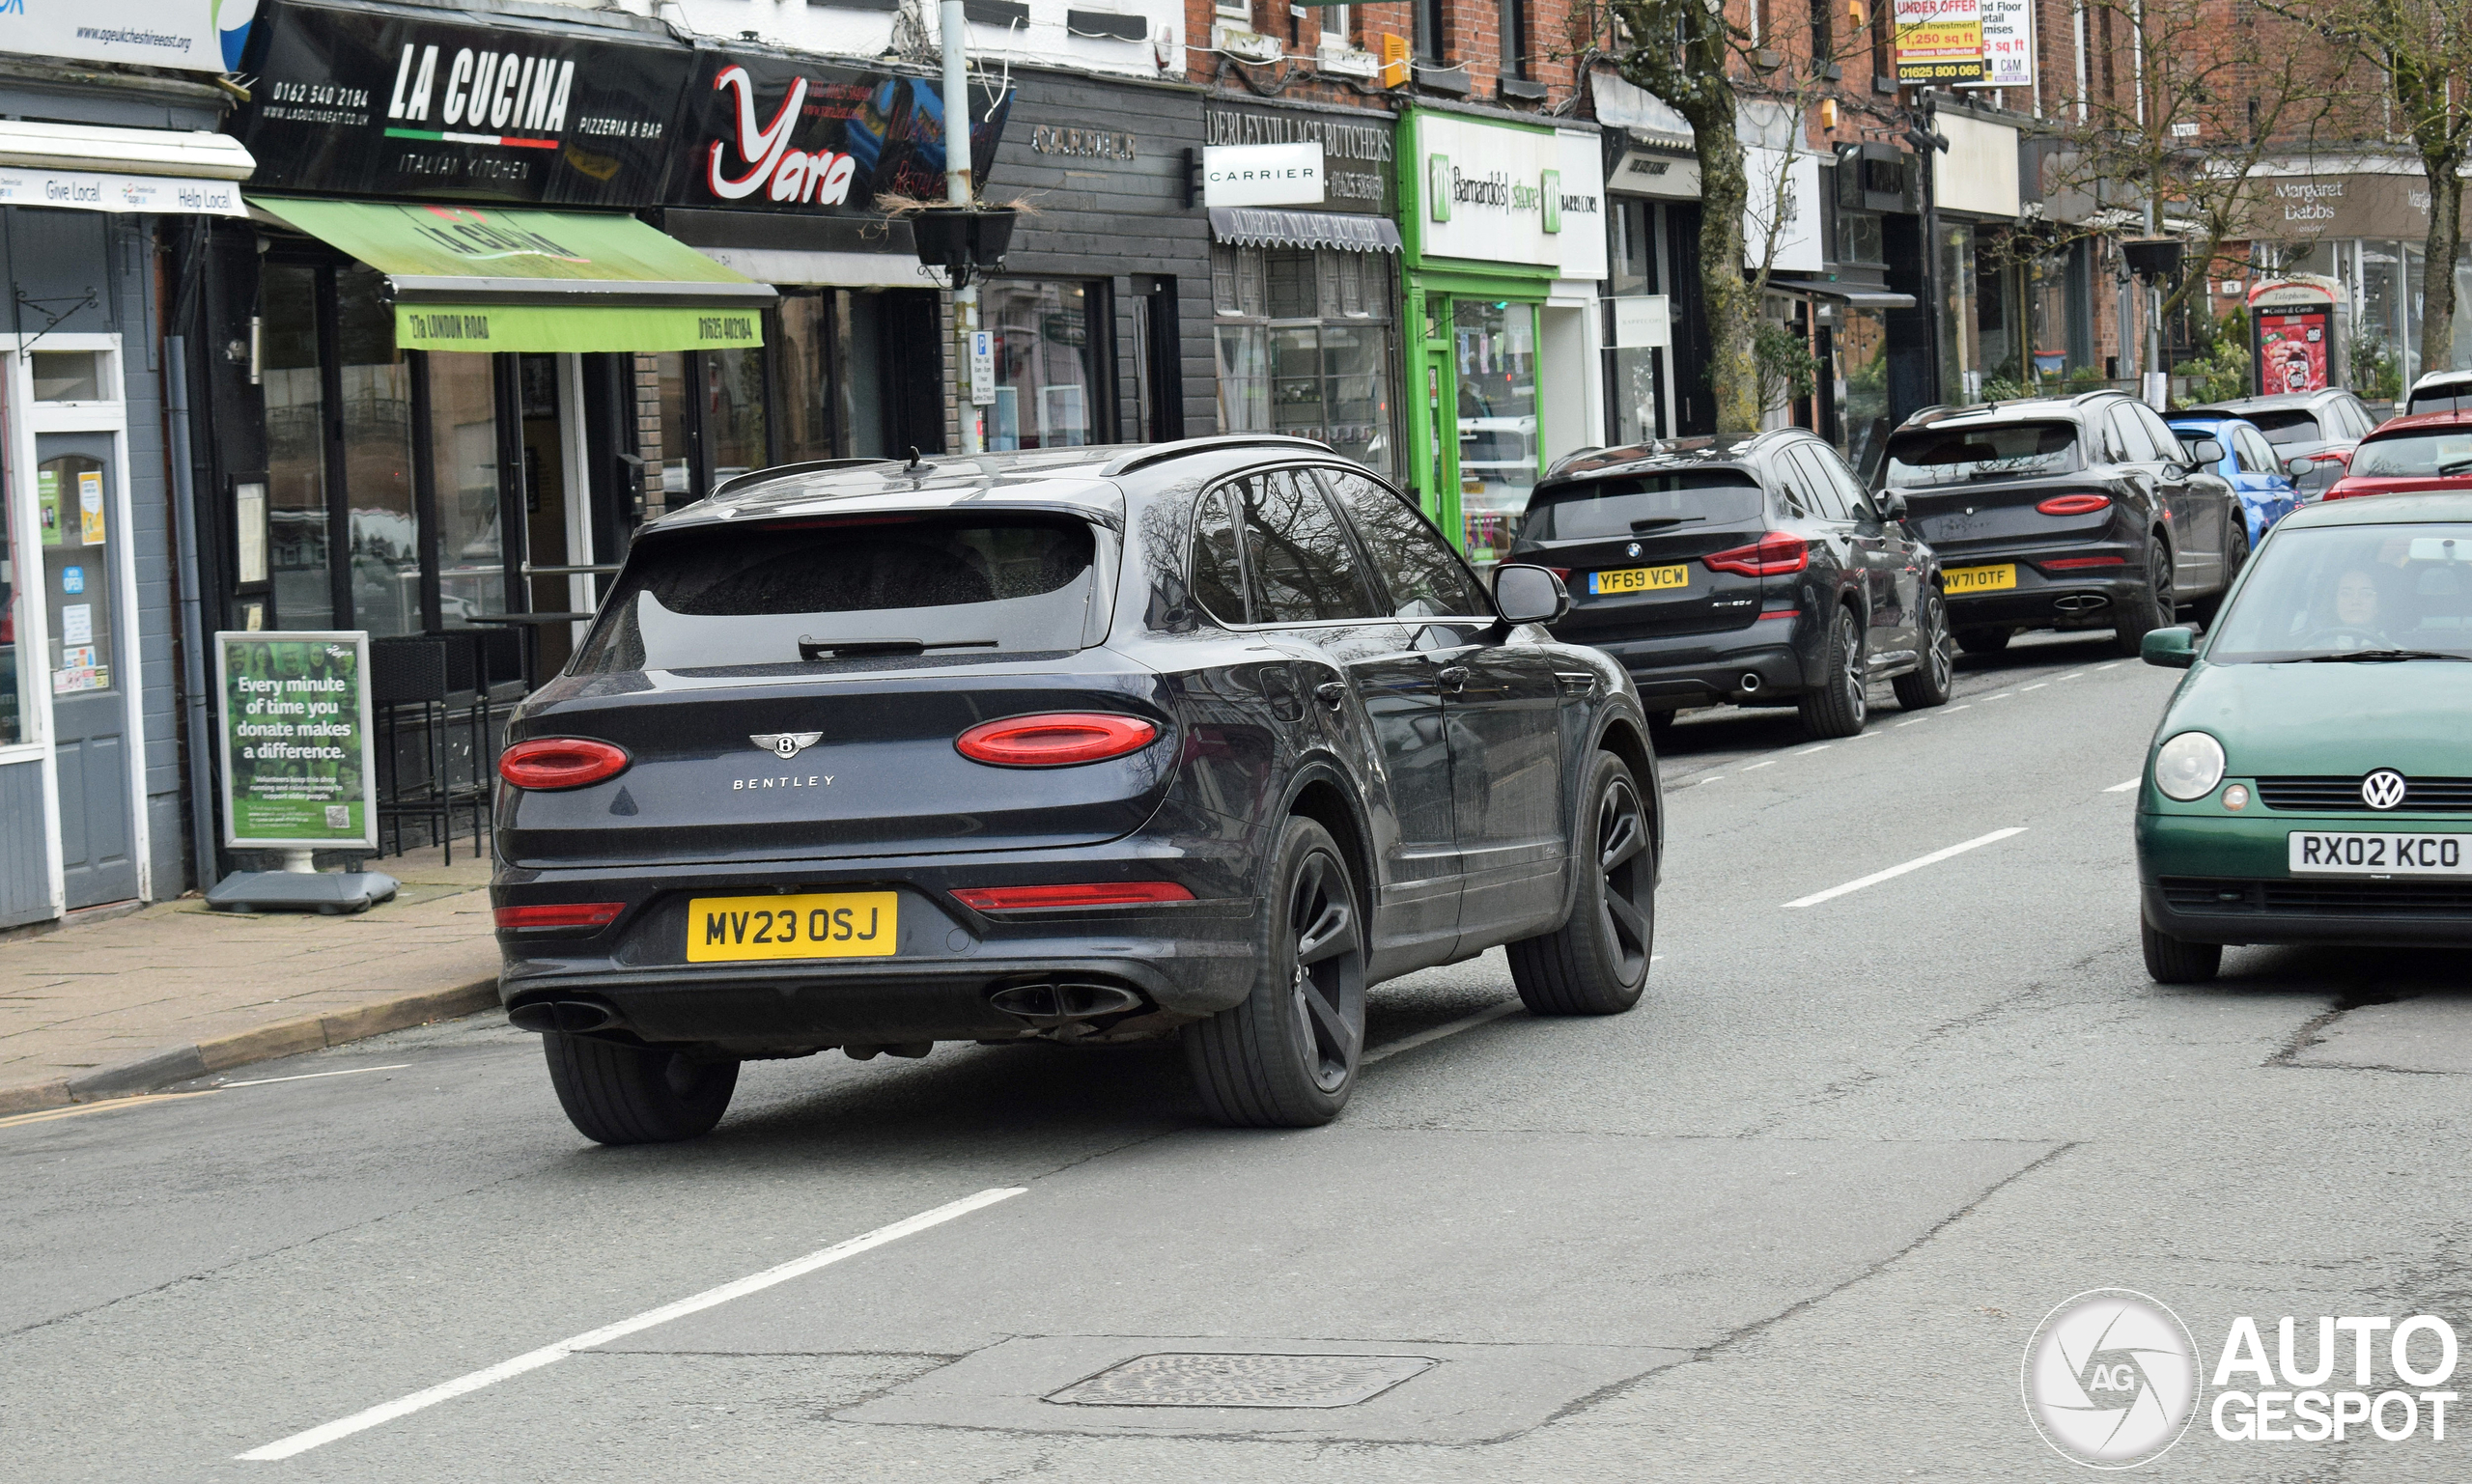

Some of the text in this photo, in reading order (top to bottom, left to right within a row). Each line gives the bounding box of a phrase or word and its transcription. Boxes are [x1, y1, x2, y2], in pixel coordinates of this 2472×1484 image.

[1897, 0, 1977, 14] UNDER OFFER
[1997, 2, 2022, 12] Floor
[1927, 21, 1977, 30] Investment
[1982, 14, 2004, 23] etail
[76, 25, 192, 52] www.ageukcheshireeast.org
[1906, 33, 1974, 46] 1,250 sq ft
[1984, 25, 2013, 34] mises
[1996, 41, 2009, 53] sq
[2014, 39, 2025, 51] ft
[1899, 67, 1933, 78] 01625
[1935, 66, 1957, 78] 800
[1958, 65, 1980, 77] 066
[2001, 59, 2022, 72] C&M
[273, 82, 369, 108] 0162 540 2184
[388, 43, 575, 132] LA CUCINA
[579, 117, 662, 140] PIZZERIA & BAR
[708, 65, 856, 207] Yara
[1032, 125, 1136, 160] CARRIER
[1324, 123, 1392, 162] BUTCHERS
[398, 154, 530, 181] ITALIAN KITCHEN
[1210, 168, 1314, 182] CARRIER
[46, 180, 100, 202] Give Local
[1452, 166, 1539, 210] Barnardo's store
[2275, 182, 2343, 203] Margaret
[179, 188, 232, 211] Help Local
[2285, 204, 2335, 220] Dabbs
[1231, 210, 1285, 236] ALDERLEY
[413, 227, 482, 253] LA
[2274, 292, 2310, 300] Telephone
[427, 315, 463, 340] LONDON
[464, 316, 490, 340] ROAD
[1600, 568, 1684, 590] YF69 VCW
[1943, 571, 2006, 587] MV71 OTF
[238, 676, 345, 695] Every minute
[245, 698, 339, 718] of time you
[237, 720, 351, 737] donate makes
[243, 742, 346, 759] a difference.
[733, 775, 835, 790] BENTLEY
[2303, 836, 2459, 867] RX02 KCO
[706, 907, 878, 945] MV23 OSJ
